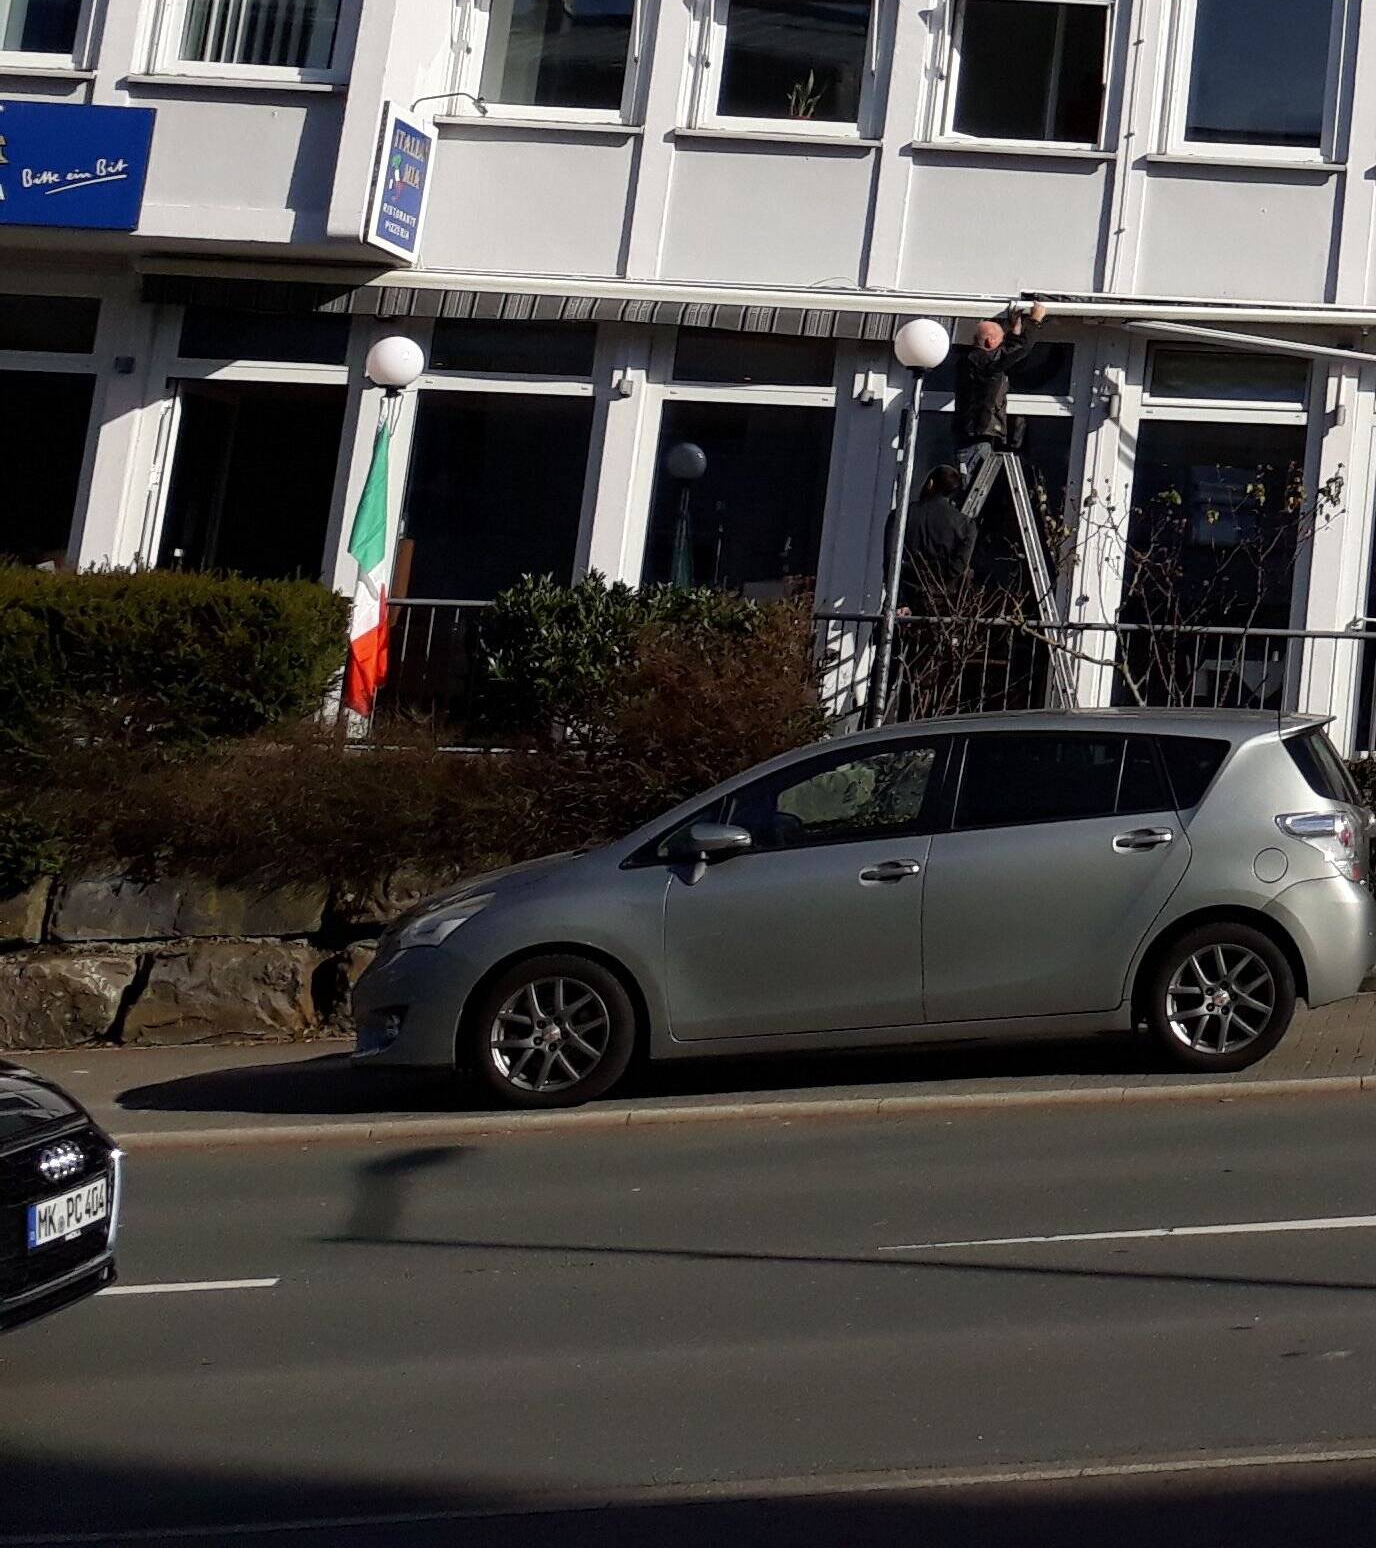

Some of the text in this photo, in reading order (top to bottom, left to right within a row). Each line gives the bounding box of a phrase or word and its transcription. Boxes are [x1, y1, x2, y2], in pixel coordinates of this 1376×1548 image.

[22, 158, 129, 188] Bitte ein Bit
[38, 1202, 57, 1240] MK
[66, 1193, 82, 1227] PC
